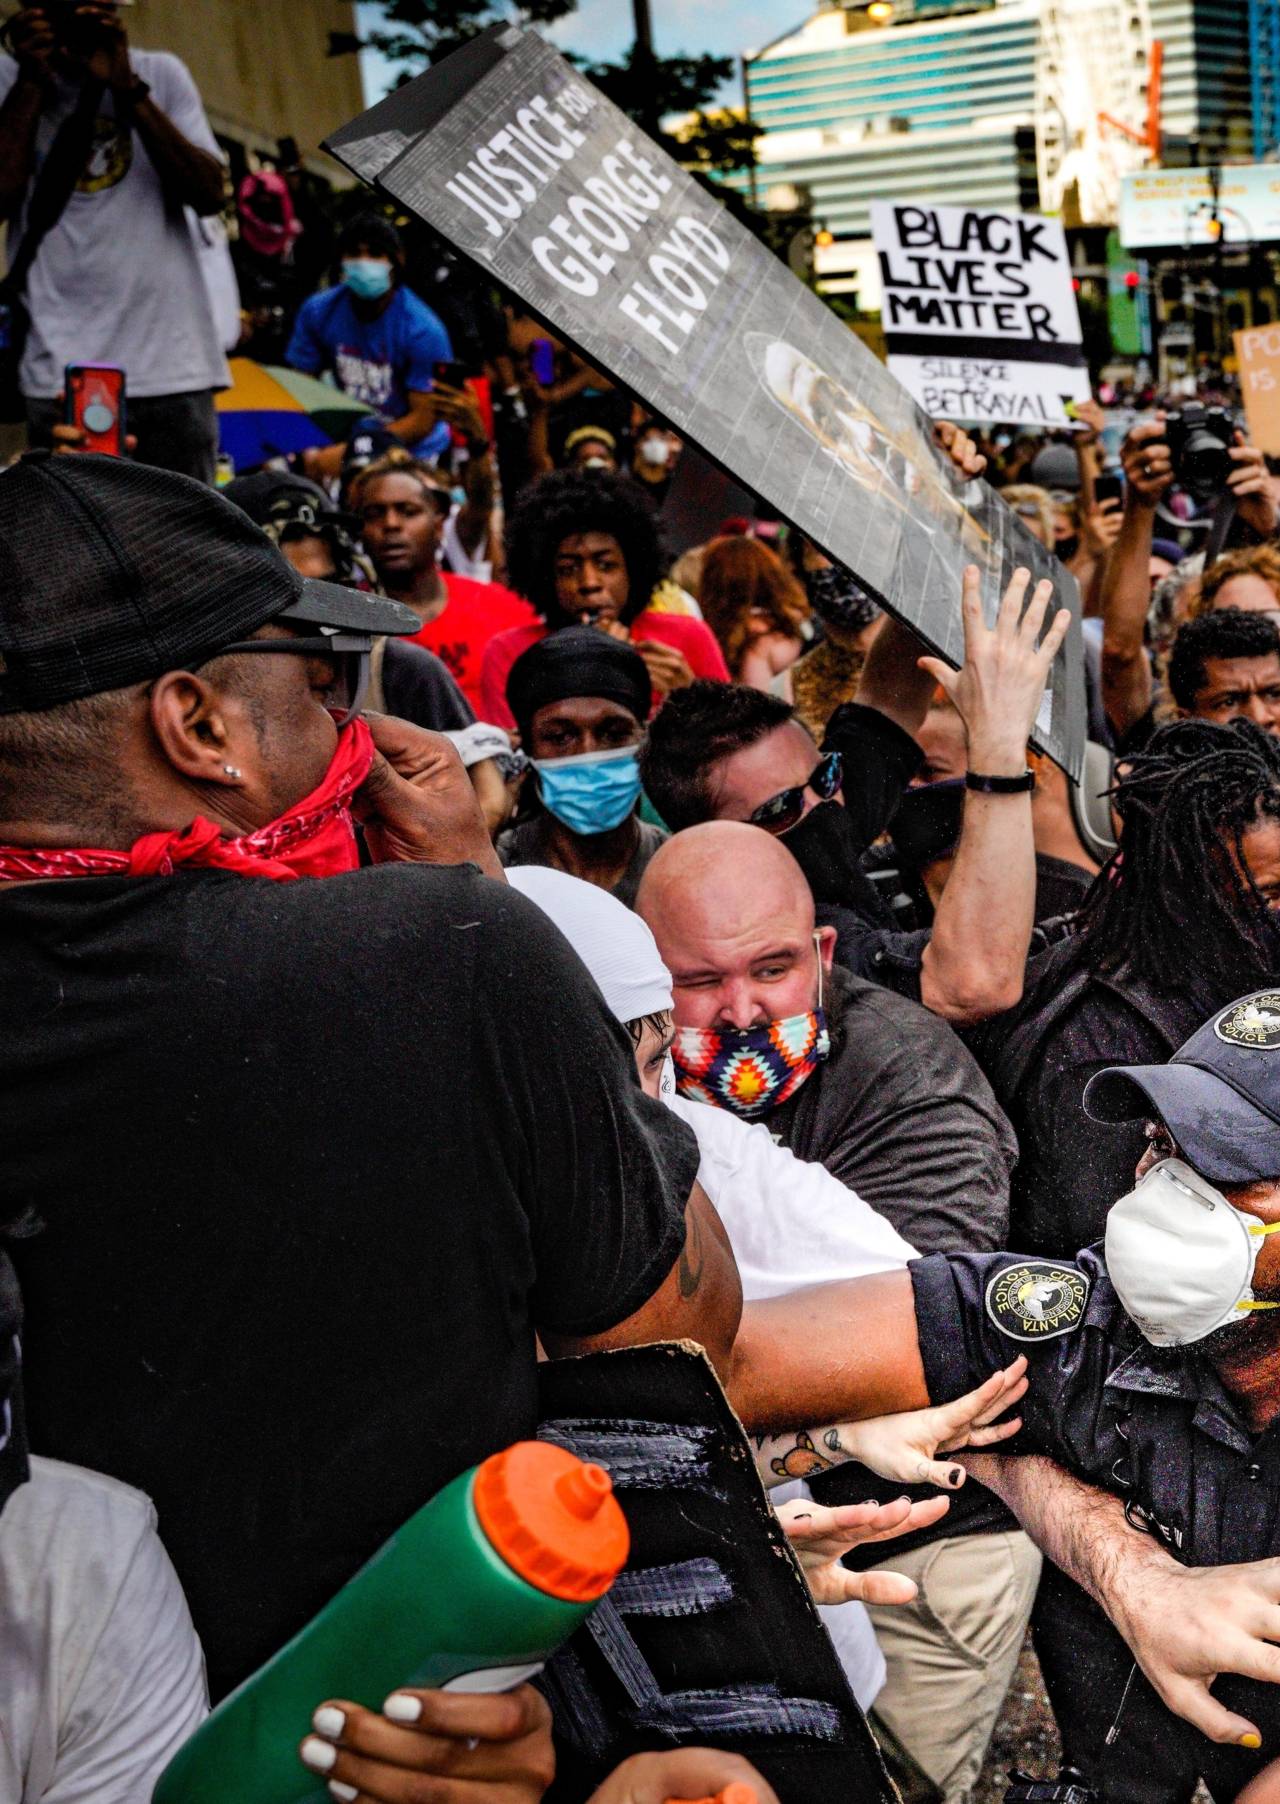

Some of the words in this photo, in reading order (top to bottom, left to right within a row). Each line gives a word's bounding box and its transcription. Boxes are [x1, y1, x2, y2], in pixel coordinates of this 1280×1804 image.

[445, 95, 586, 237] JUSTICE
[555, 84, 597, 122] FOR
[532, 139, 672, 296] GEORGE
[893, 206, 1060, 262] BLACK
[618, 216, 731, 355] FLOYD
[878, 251, 1030, 298] LIVES
[887, 293, 1060, 342] MATTER
[919, 359, 1010, 381] SILENCE
[961, 380, 990, 395] IS
[1250, 369, 1276, 391] IS
[1222, 1021, 1267, 1043] POLICE
[995, 1268, 1031, 1314] POLICE
[1050, 1271, 1080, 1285] CITY
[1073, 1286, 1084, 1305] OF
[1023, 1303, 1081, 1332] ATLANTA
